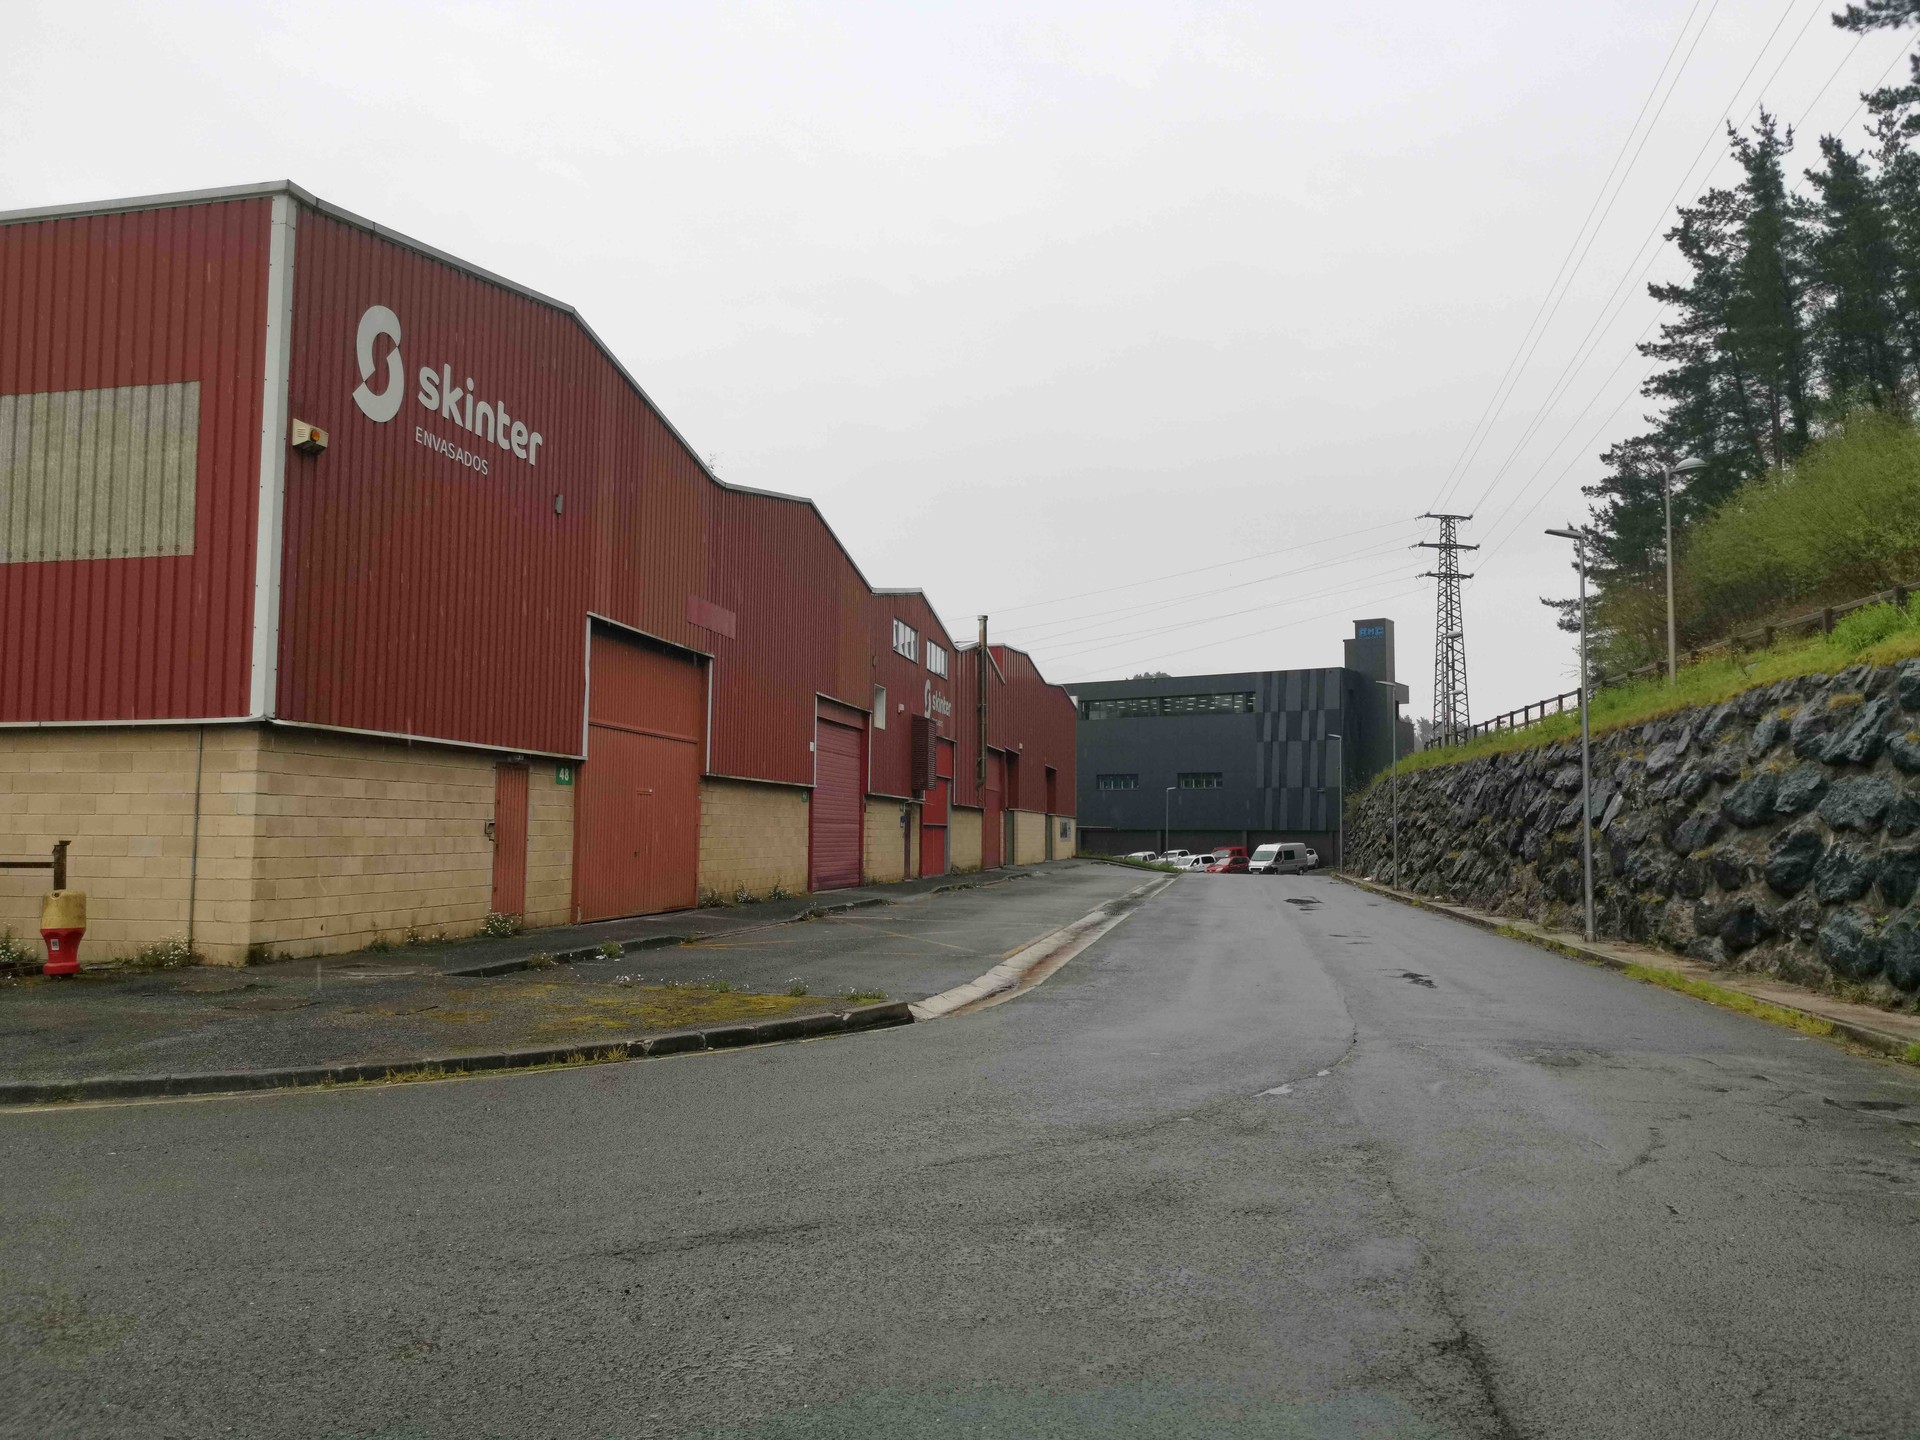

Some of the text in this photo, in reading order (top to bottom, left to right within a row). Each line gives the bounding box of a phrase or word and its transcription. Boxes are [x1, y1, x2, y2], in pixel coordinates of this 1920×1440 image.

[418, 363, 543, 466] skinter
[415, 426, 489, 475] ENVASADOS
[932, 690, 952, 718] skinter
[559, 767, 570, 781] 48
